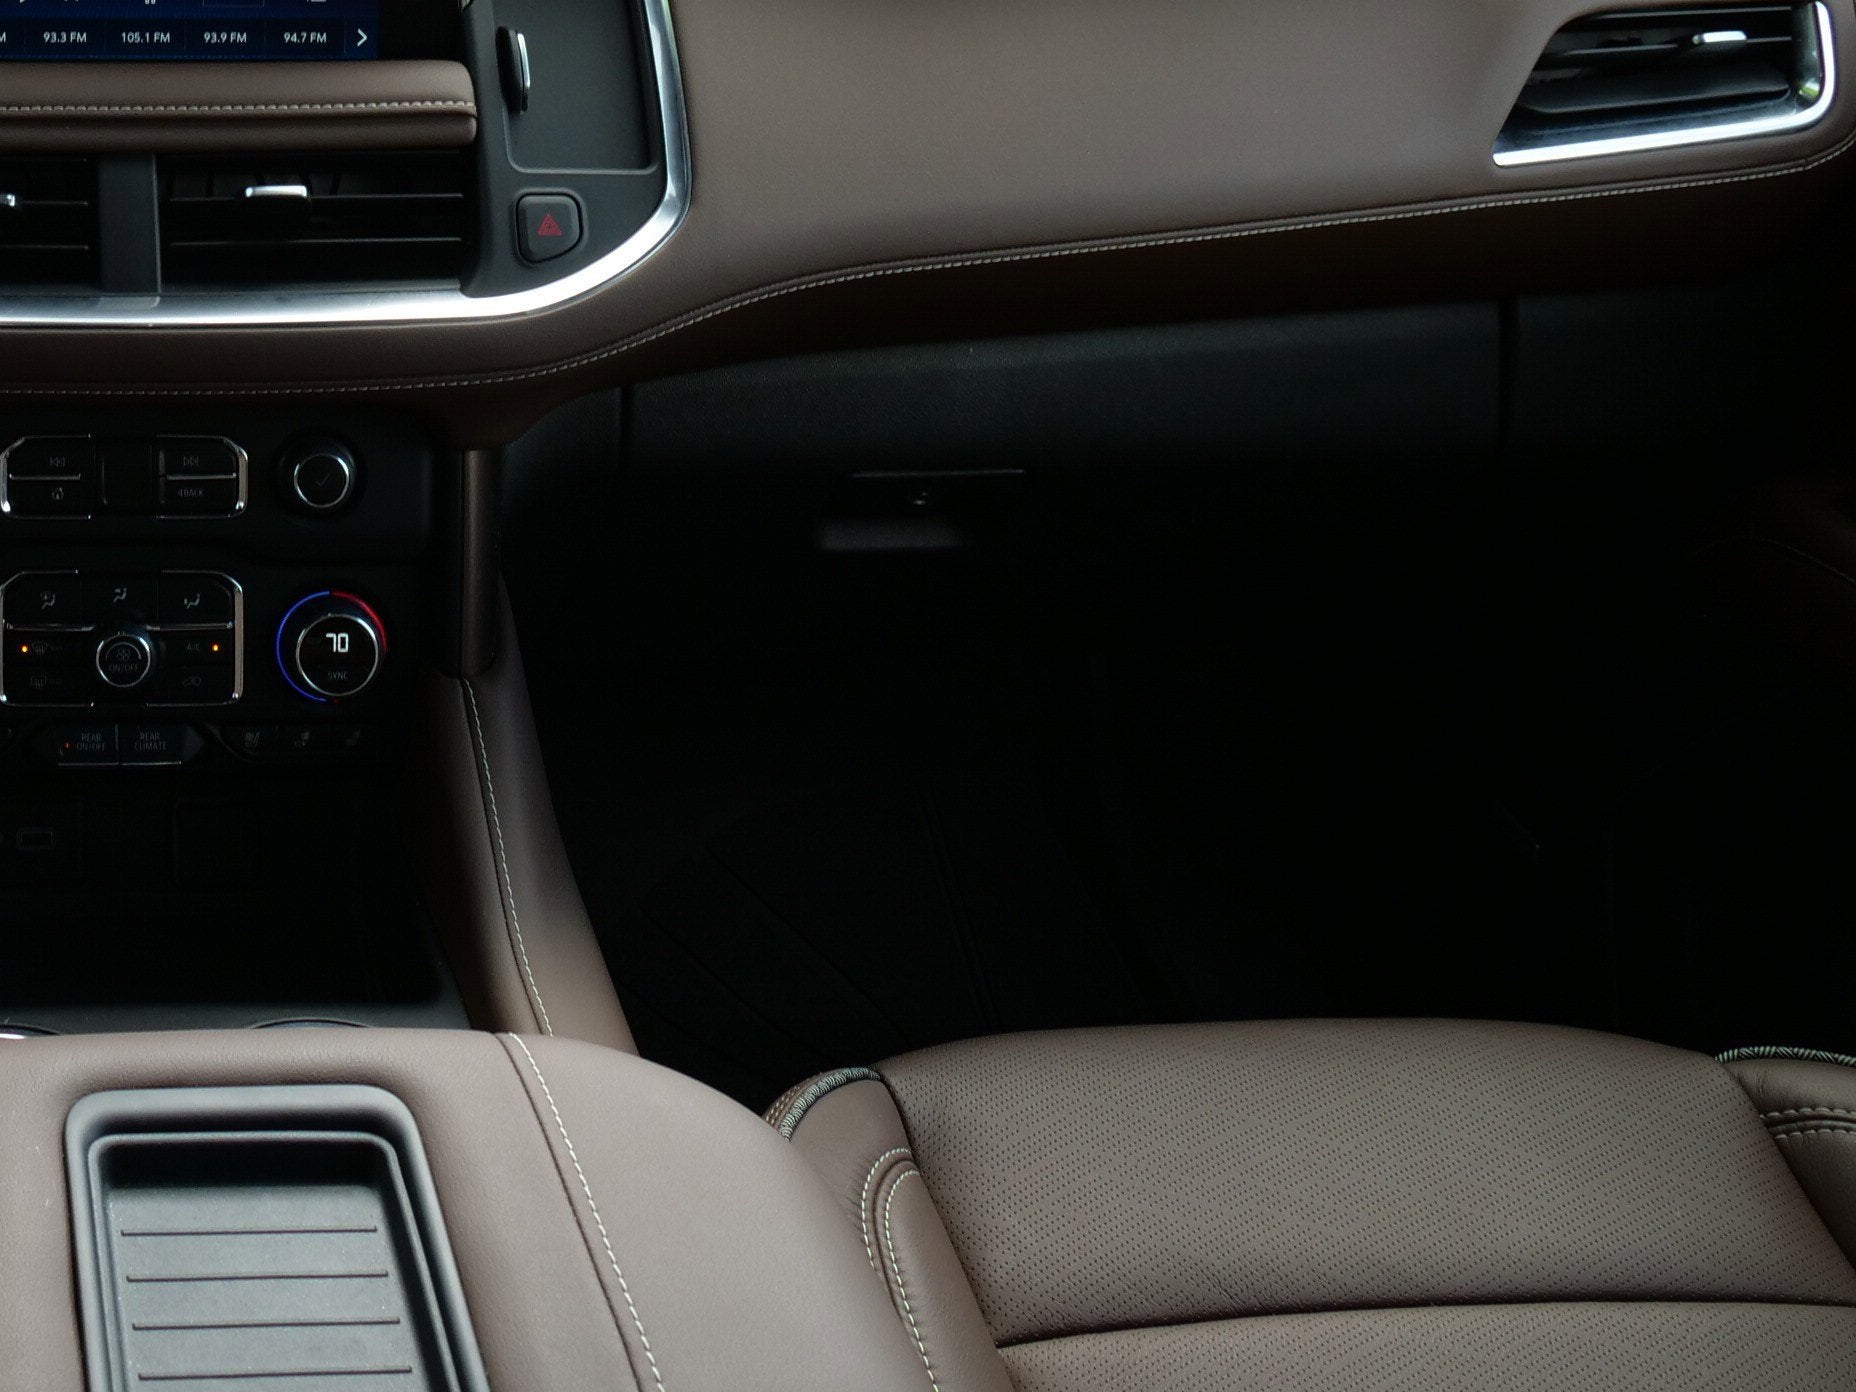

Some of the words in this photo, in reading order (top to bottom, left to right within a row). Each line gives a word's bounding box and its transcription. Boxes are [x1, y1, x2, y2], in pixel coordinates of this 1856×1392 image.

[43, 31, 67, 44] 93.3
[70, 31, 87, 43] FM
[121, 31, 150, 44] 105.1
[154, 31, 171, 43] FM
[204, 31, 227, 44] 93.9
[230, 31, 247, 43] FM
[284, 31, 307, 44] 94.7
[310, 31, 327, 43] FM
[183, 488, 203, 498] BACK
[325, 632, 350, 654] 70
[108, 662, 142, 673] ON/OFF
[327, 670, 350, 682] SYNC
[81, 732, 102, 743] REAR
[139, 731, 161, 742] REAR
[76, 742, 106, 753] ON/OFF
[134, 741, 169, 753] CLIMATE
